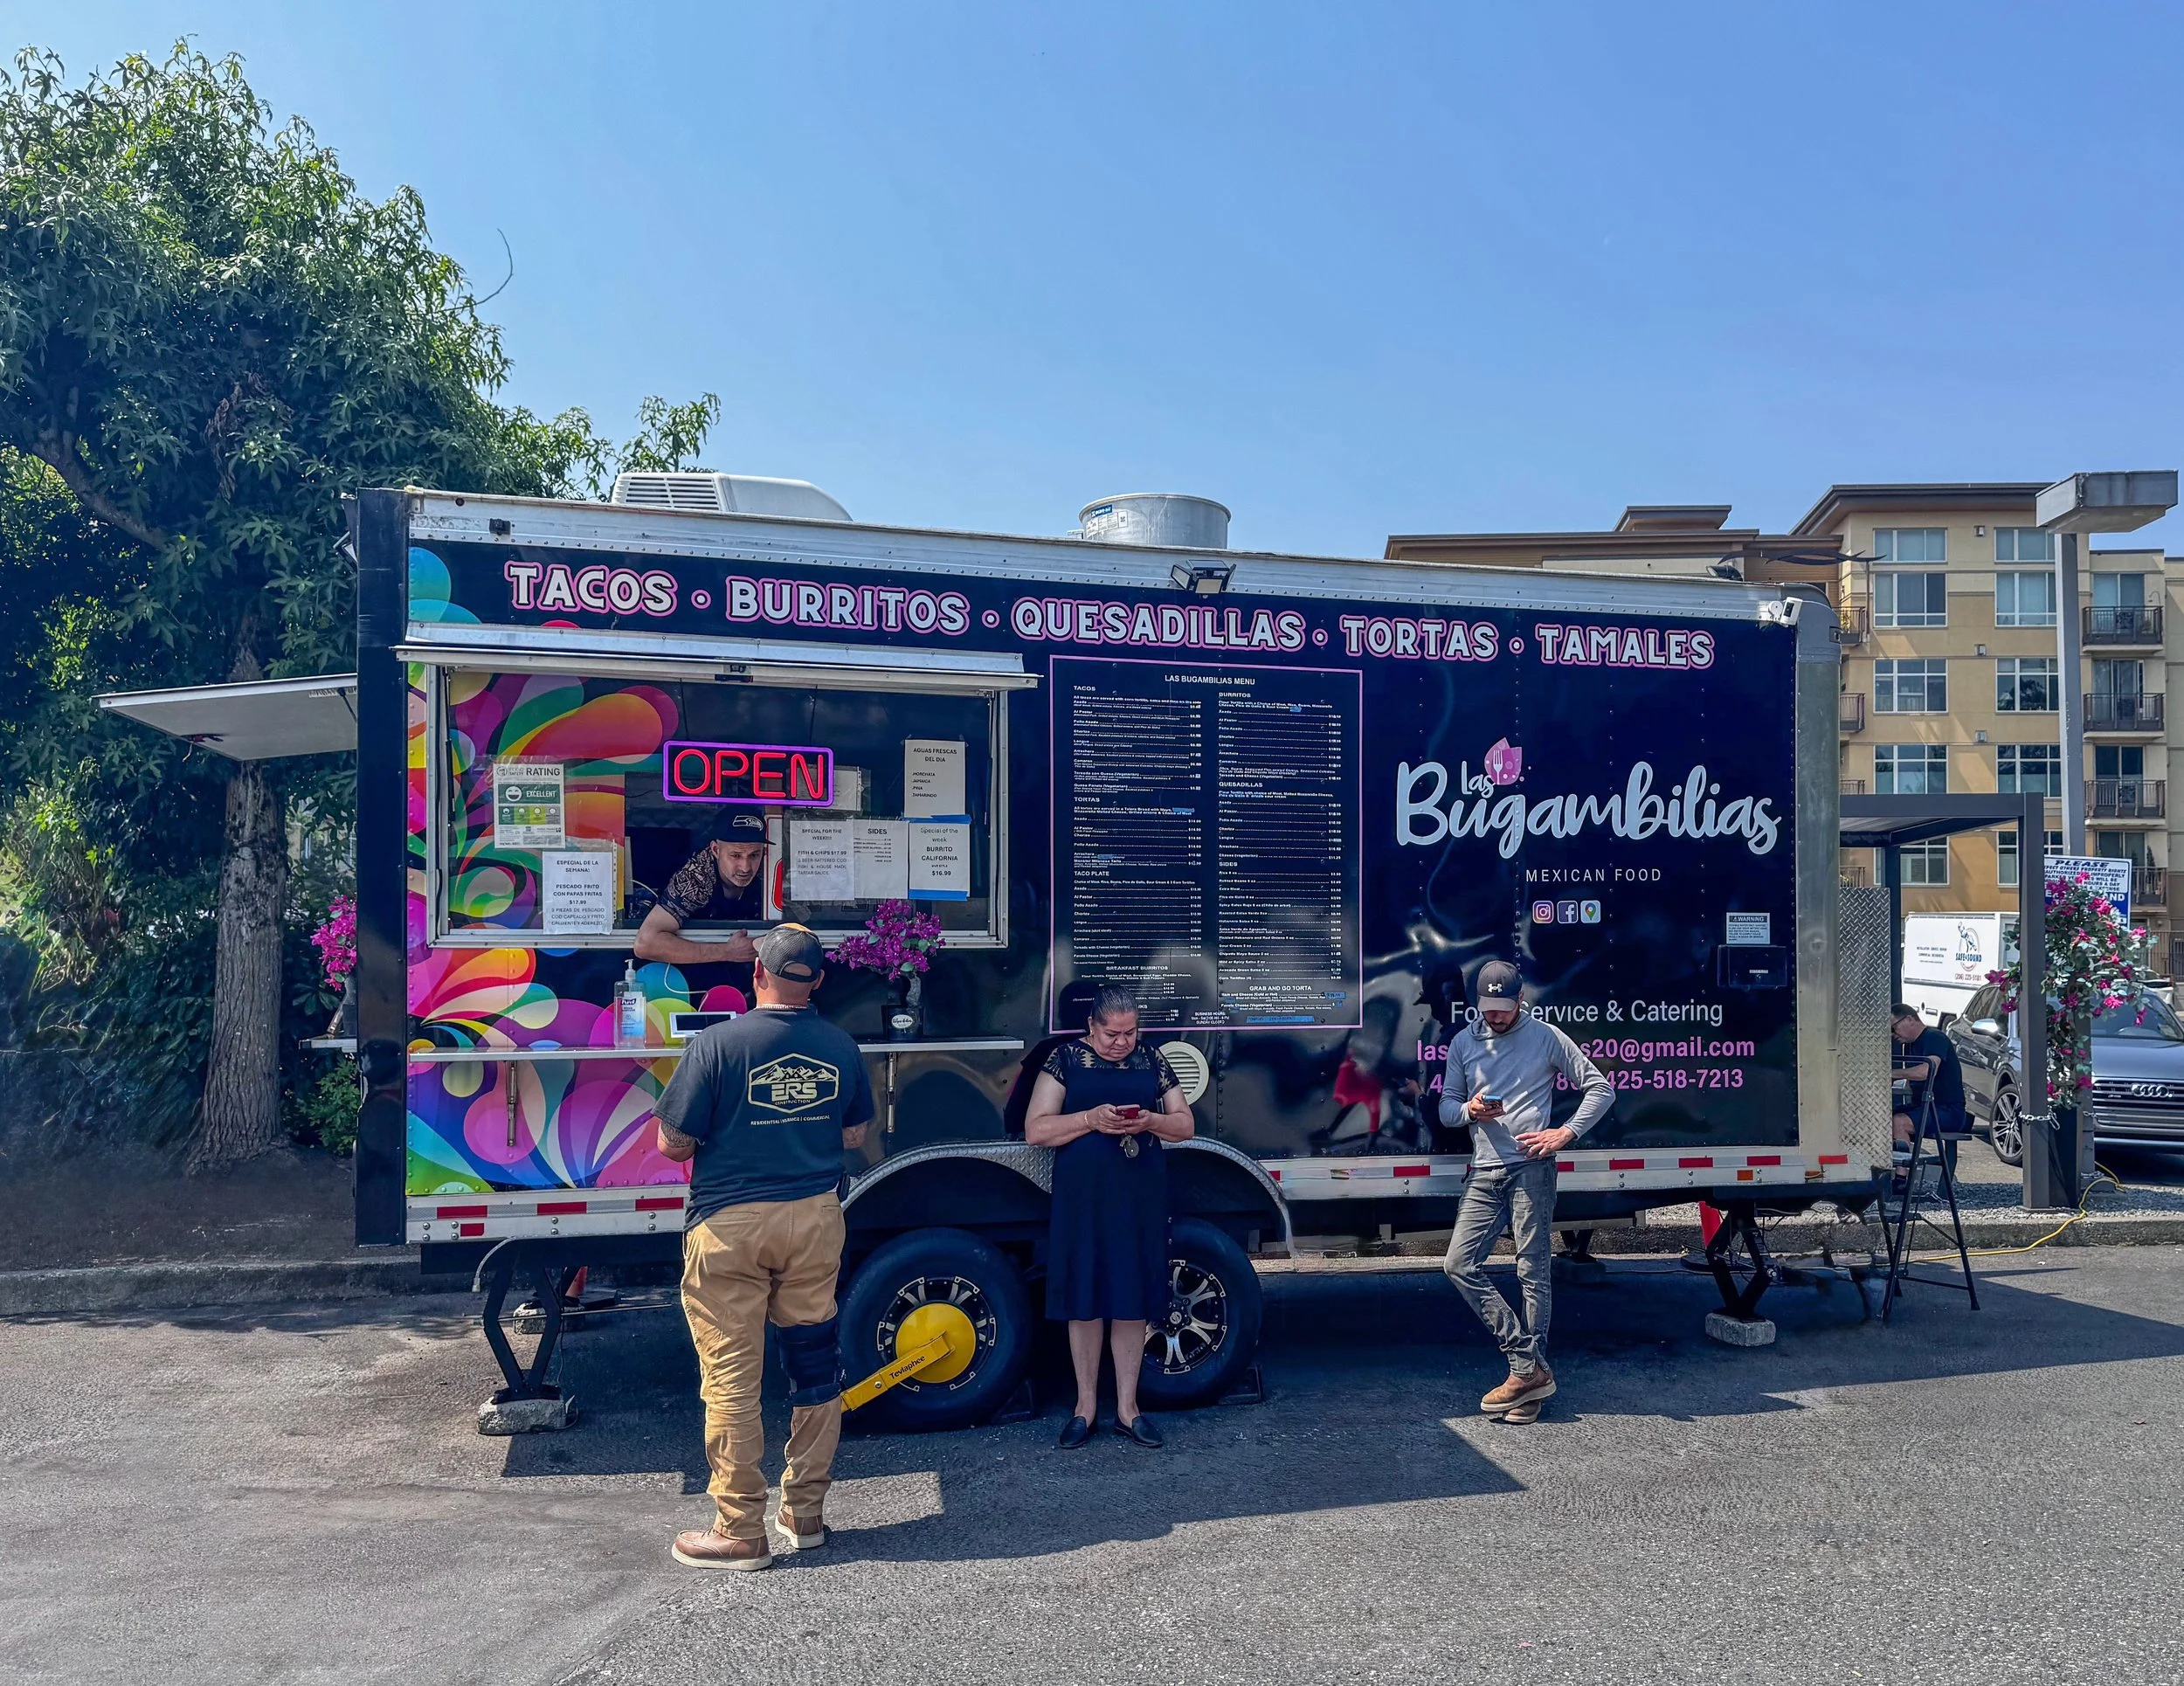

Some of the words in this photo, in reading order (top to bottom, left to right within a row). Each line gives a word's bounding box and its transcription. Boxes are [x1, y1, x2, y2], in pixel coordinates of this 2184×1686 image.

[505, 562, 676, 616] TACOS
[727, 577, 969, 633] BURRITOS
[1013, 598, 1303, 652] QUESADILLAS
[1341, 616, 1497, 660] TORTAS
[1537, 624, 1713, 667] TAMALES
[1181, 676, 1232, 684] BUGAMBILIAS
[526, 768, 560, 776] RATING
[674, 749, 823, 798] OPEN
[1461, 761, 1495, 796] Las
[1396, 761, 1782, 859] Bugambilias
[1526, 869, 1605, 882] MEXICAN
[1615, 869, 1662, 881] FOOD
[1606, 1001, 1624, 1022] &
[1631, 999, 1723, 1026] Catering
[772, 1082, 817, 1101] ERS
